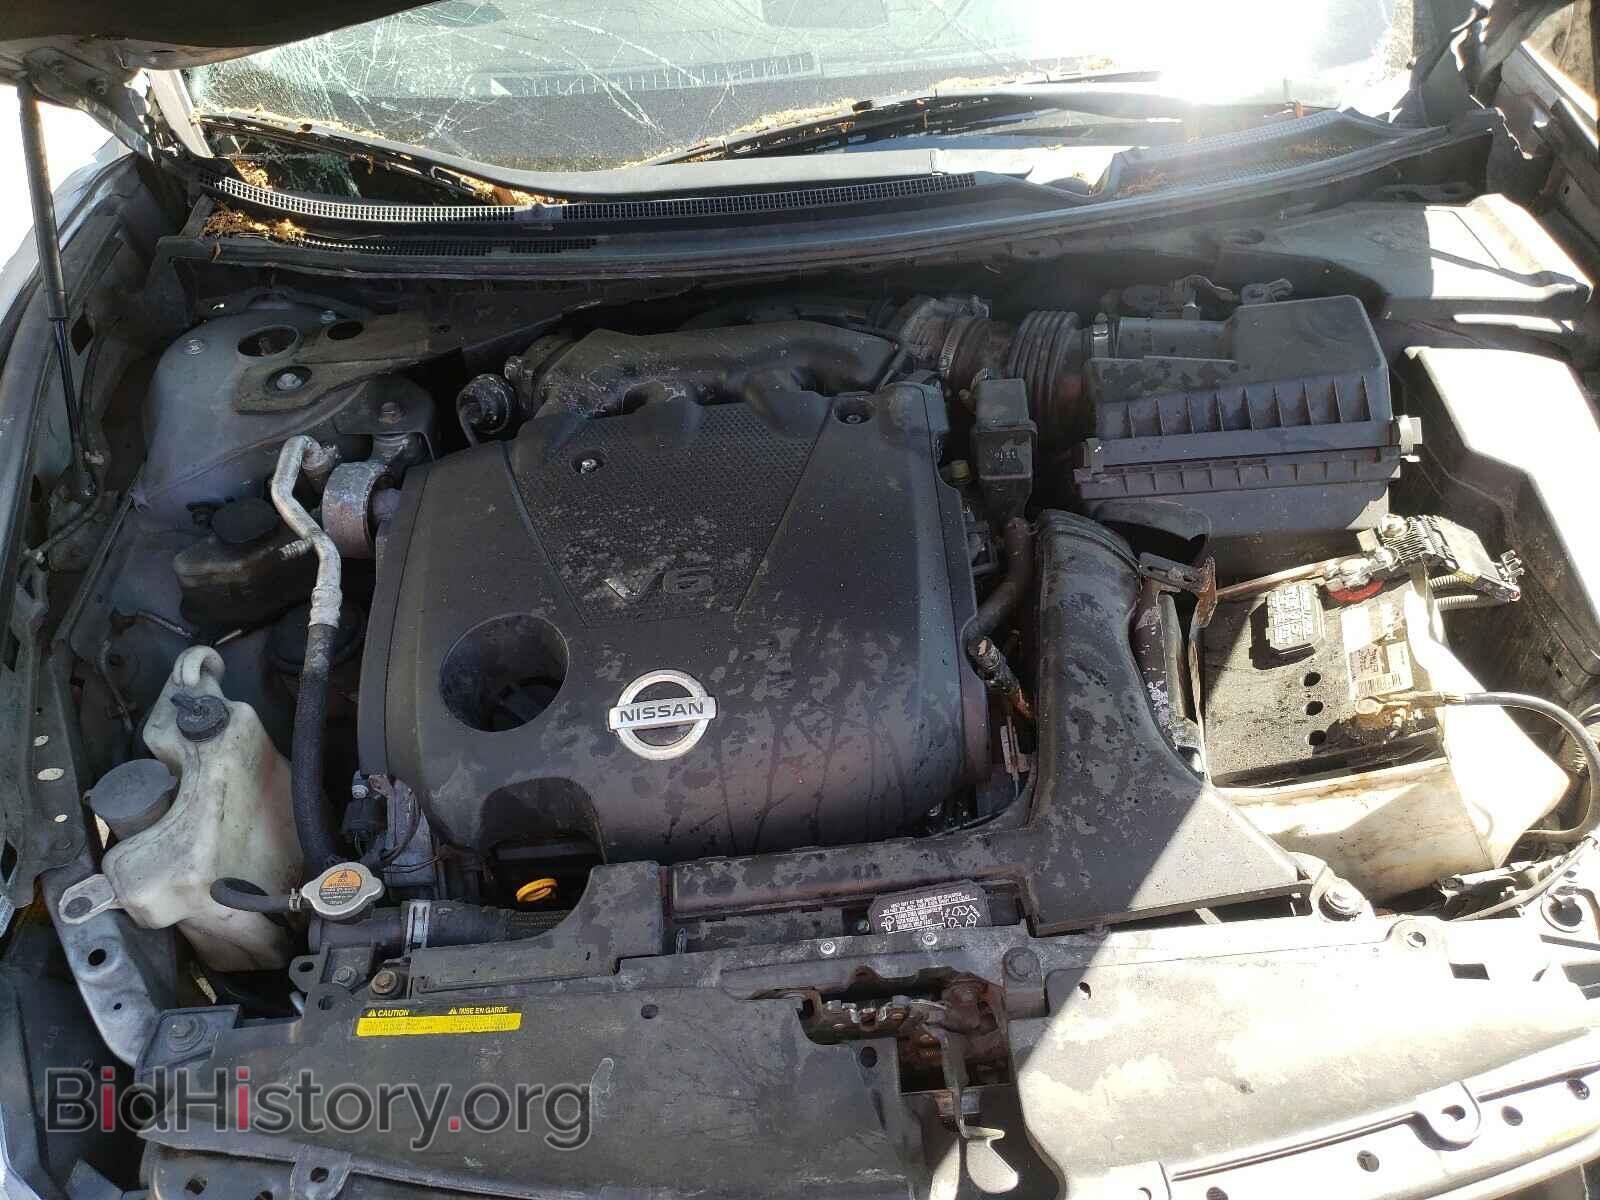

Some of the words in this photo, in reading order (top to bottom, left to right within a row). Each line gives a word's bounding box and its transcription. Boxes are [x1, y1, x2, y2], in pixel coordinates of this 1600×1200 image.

[601, 566, 713, 601] V6
[619, 701, 704, 723] NISSAN
[377, 1009, 410, 1017] CAUTION
[459, 1007, 475, 1015] MISE
[485, 1006, 508, 1014] GARDE
